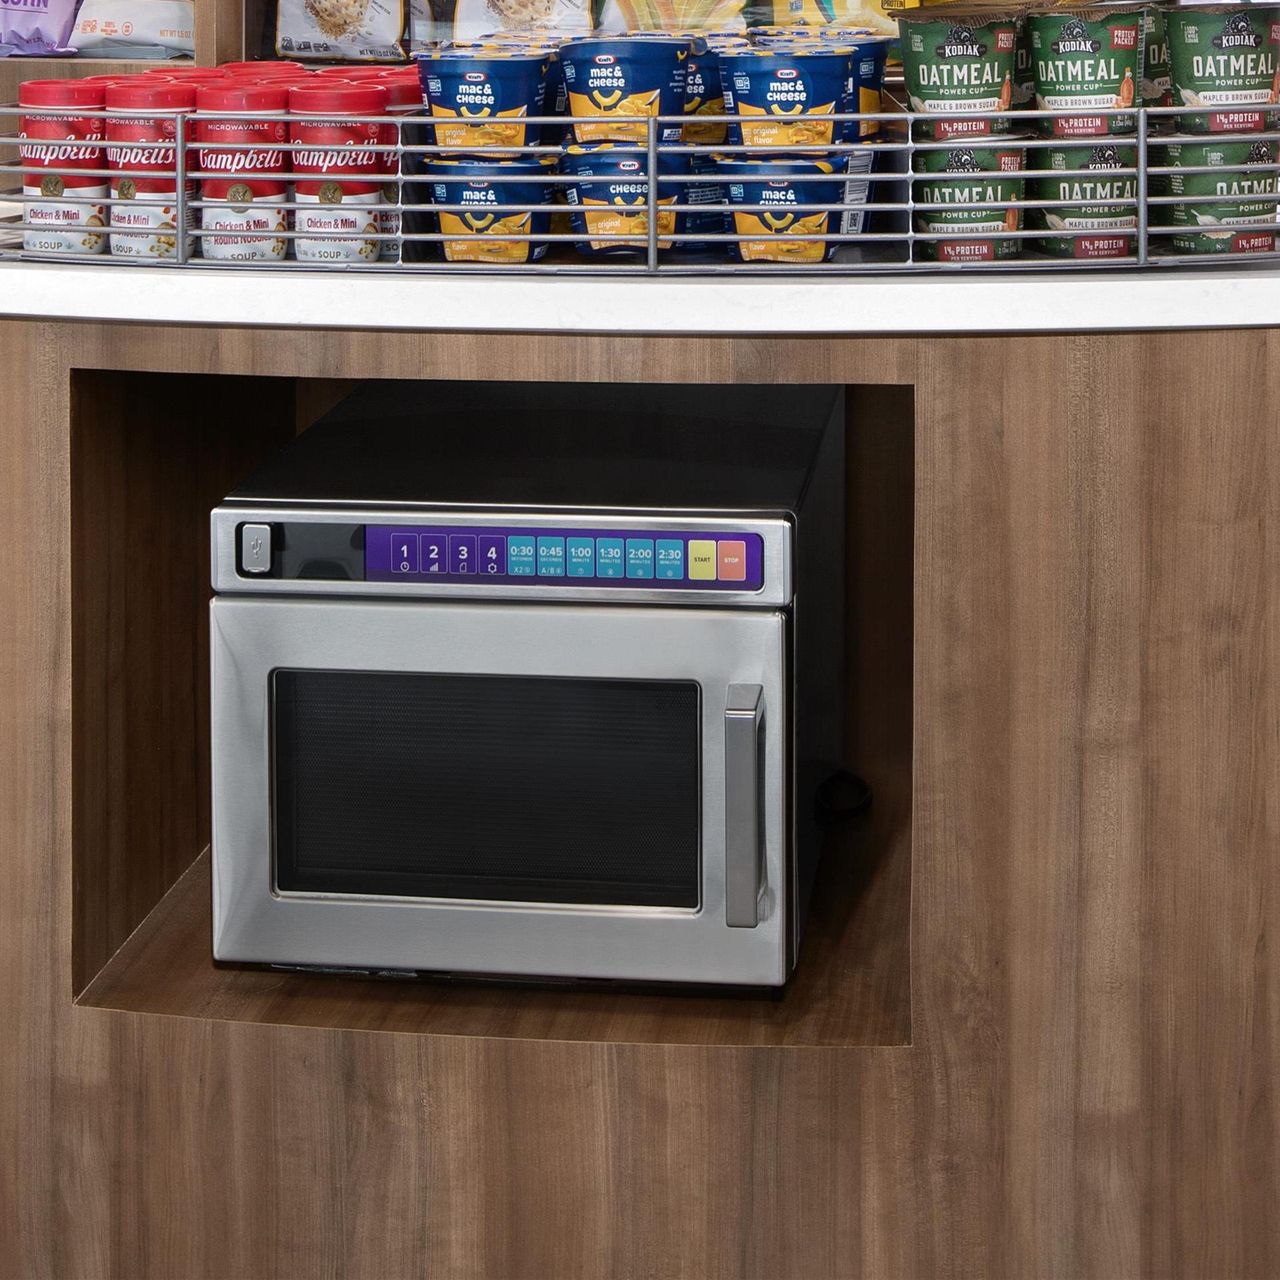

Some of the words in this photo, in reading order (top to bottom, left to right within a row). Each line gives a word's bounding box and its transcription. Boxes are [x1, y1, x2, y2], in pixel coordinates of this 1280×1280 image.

[1059, 40, 1093, 53] KODIAK
[1222, 35, 1255, 48] KODIAK
[945, 44, 979, 57] KODIAK
[1039, 59, 1119, 81] OATMEAL
[1193, 53, 1274, 77] OATMEAL
[590, 67, 613, 77] mac
[919, 62, 1001, 86] OATMEAL
[459, 84, 482, 94] mac
[770, 81, 794, 91] mac
[445, 127, 466, 137] original
[941, 123, 952, 132] 14g
[953, 122, 984, 130] PROTEIN
[30, 208, 53, 219] Chicken
[62, 209, 80, 220] Mini
[215, 219, 244, 230] Chicken
[253, 218, 269, 230] Mini
[38, 241, 63, 249] SOUP
[401, 545, 408, 557] 1
[429, 546, 439, 558] 2
[458, 546, 468, 559] 3
[487, 547, 497, 560] 4
[510, 546, 533, 556] 0:30
[540, 547, 563, 557] 0:45
[570, 547, 591, 558] 1:00
[600, 548, 620, 558] 1:30
[629, 549, 652, 558] 2:00
[659, 550, 681, 559] 2:30
